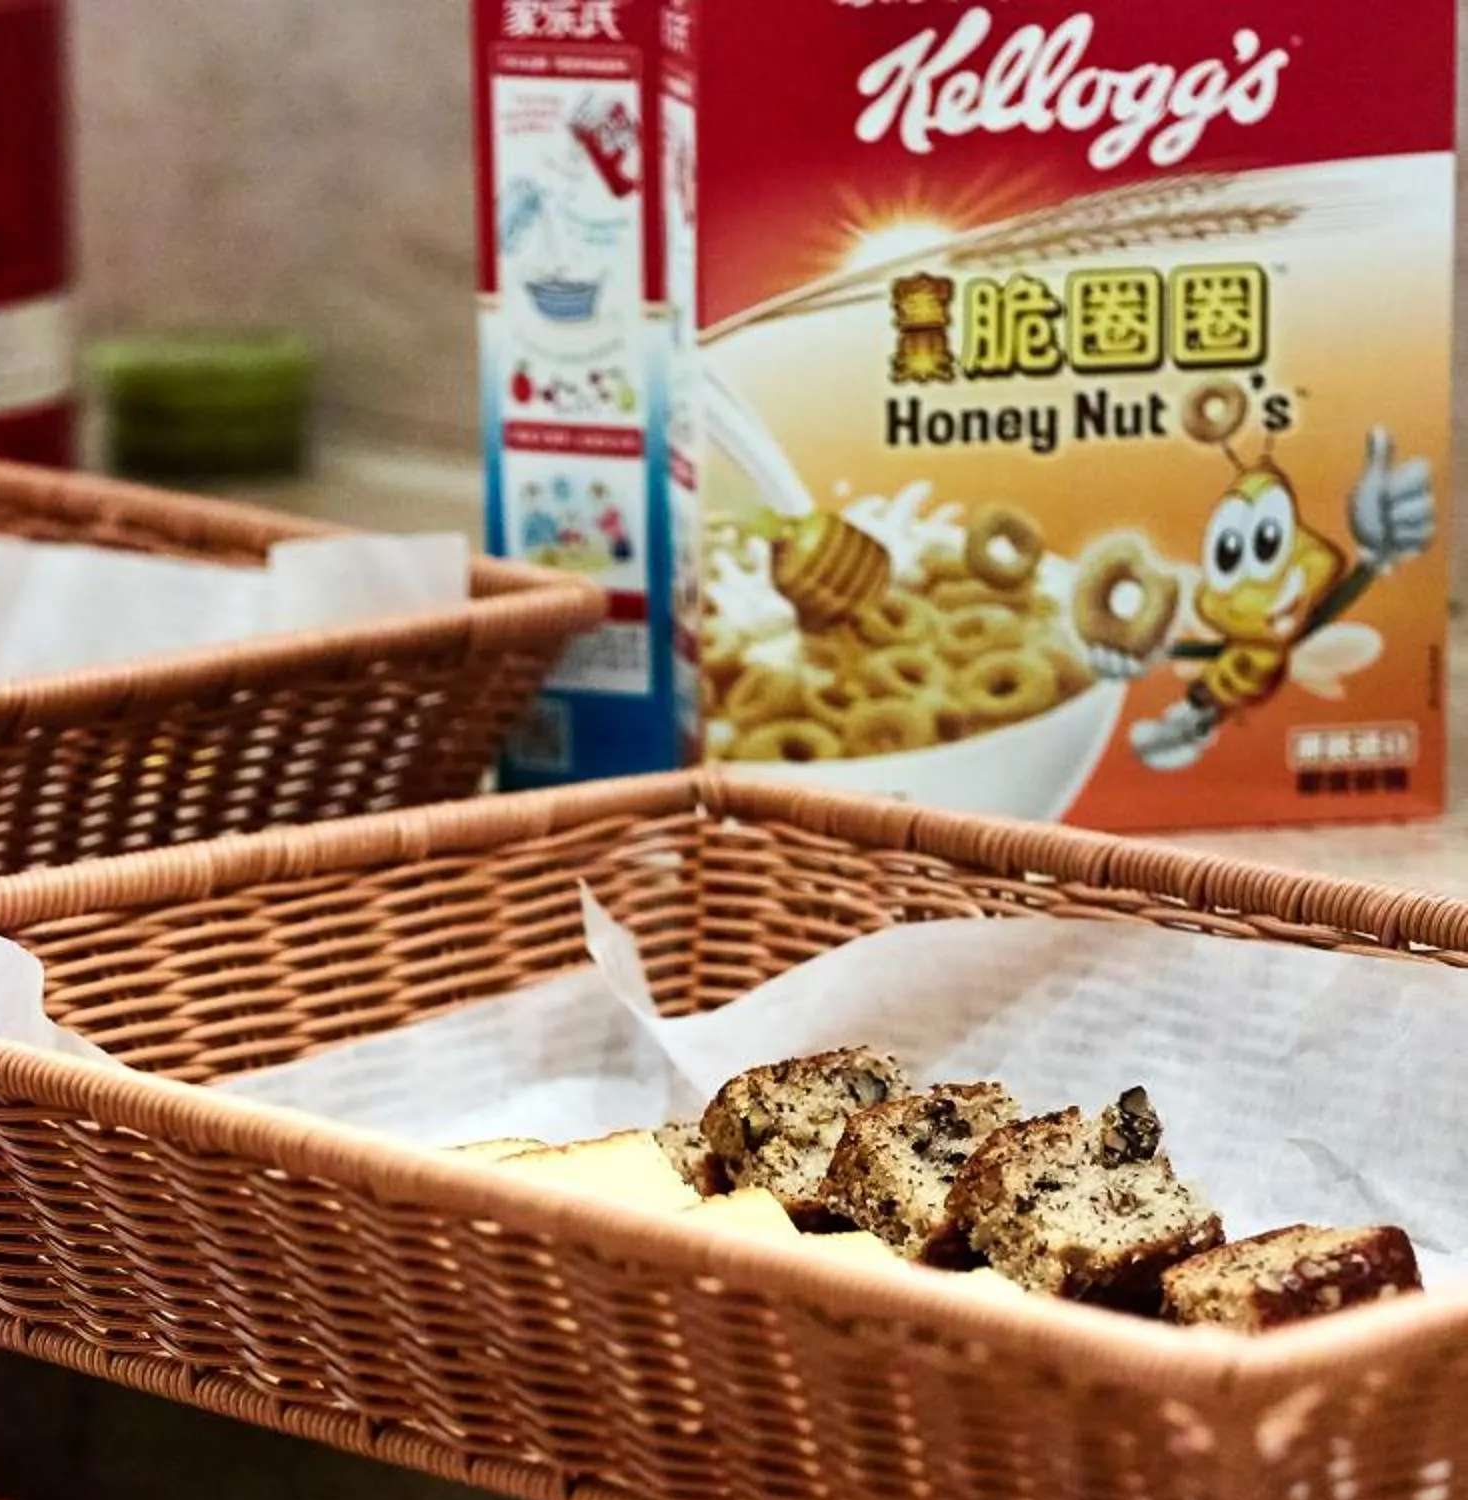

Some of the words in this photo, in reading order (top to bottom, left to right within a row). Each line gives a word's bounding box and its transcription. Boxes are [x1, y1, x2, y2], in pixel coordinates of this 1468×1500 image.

[855, 6, 1290, 170] Kellogg's
[886, 397, 1058, 454] Honey
[1074, 389, 1168, 439] Nut
